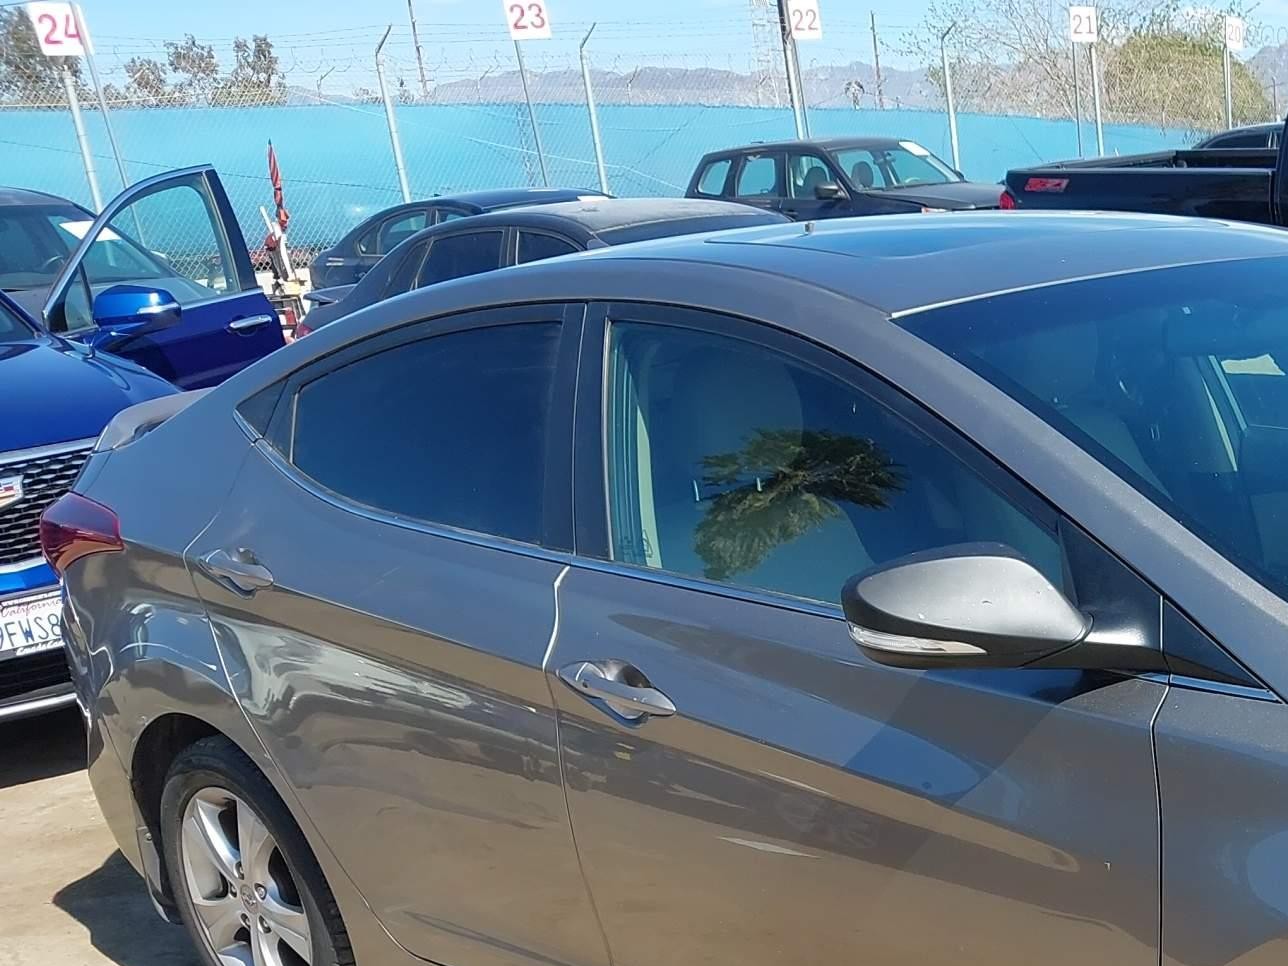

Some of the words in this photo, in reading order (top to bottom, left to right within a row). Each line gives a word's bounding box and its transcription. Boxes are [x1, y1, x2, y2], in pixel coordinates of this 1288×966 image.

[509, 3, 545, 29] 23
[792, 9, 818, 31] 22
[1073, 14, 1095, 34] 21
[38, 13, 82, 45] 24
